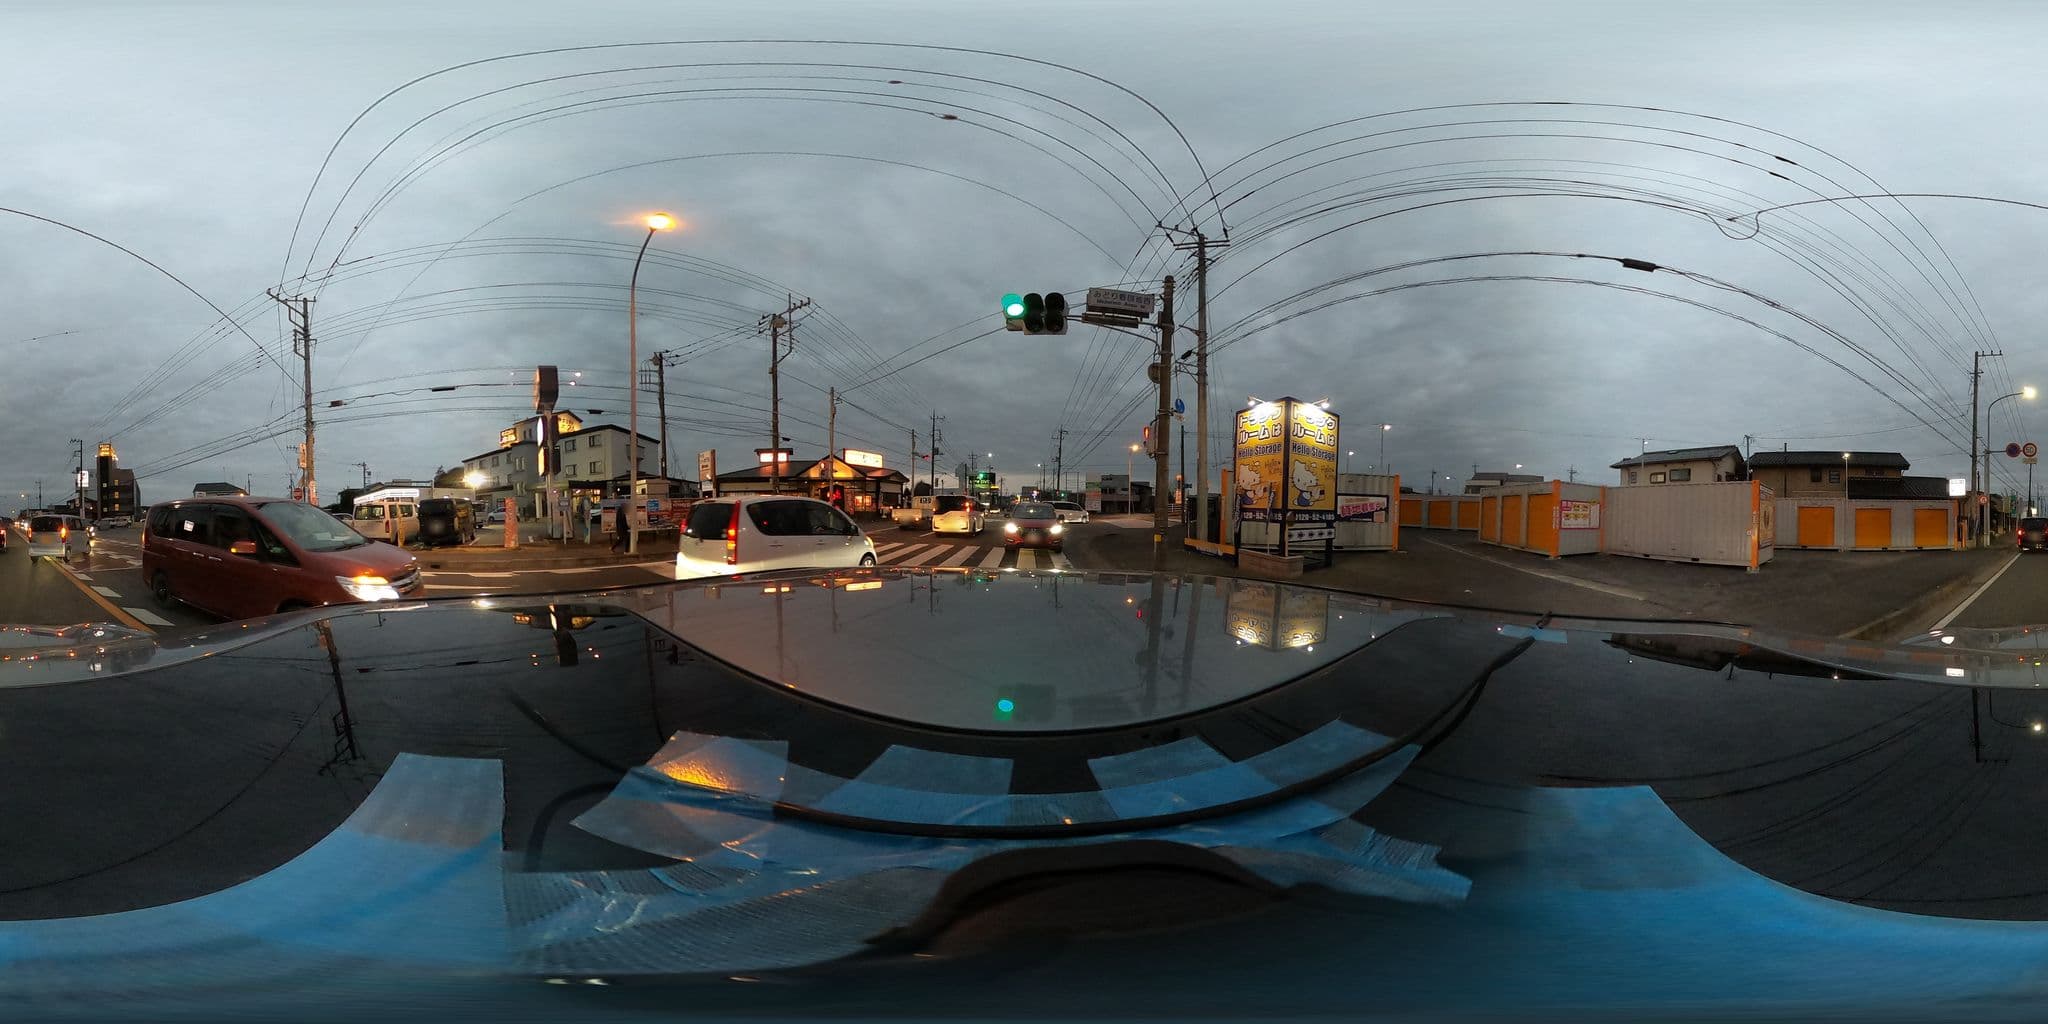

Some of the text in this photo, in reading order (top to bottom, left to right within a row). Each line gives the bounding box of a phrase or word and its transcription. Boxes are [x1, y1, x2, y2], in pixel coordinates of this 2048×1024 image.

[1238, 423, 1282, 445] ルームは
[1293, 423, 1336, 447] ルームは
[1238, 443, 1282, 459] Hello Storage
[1292, 442, 1336, 461] Hello Storage
